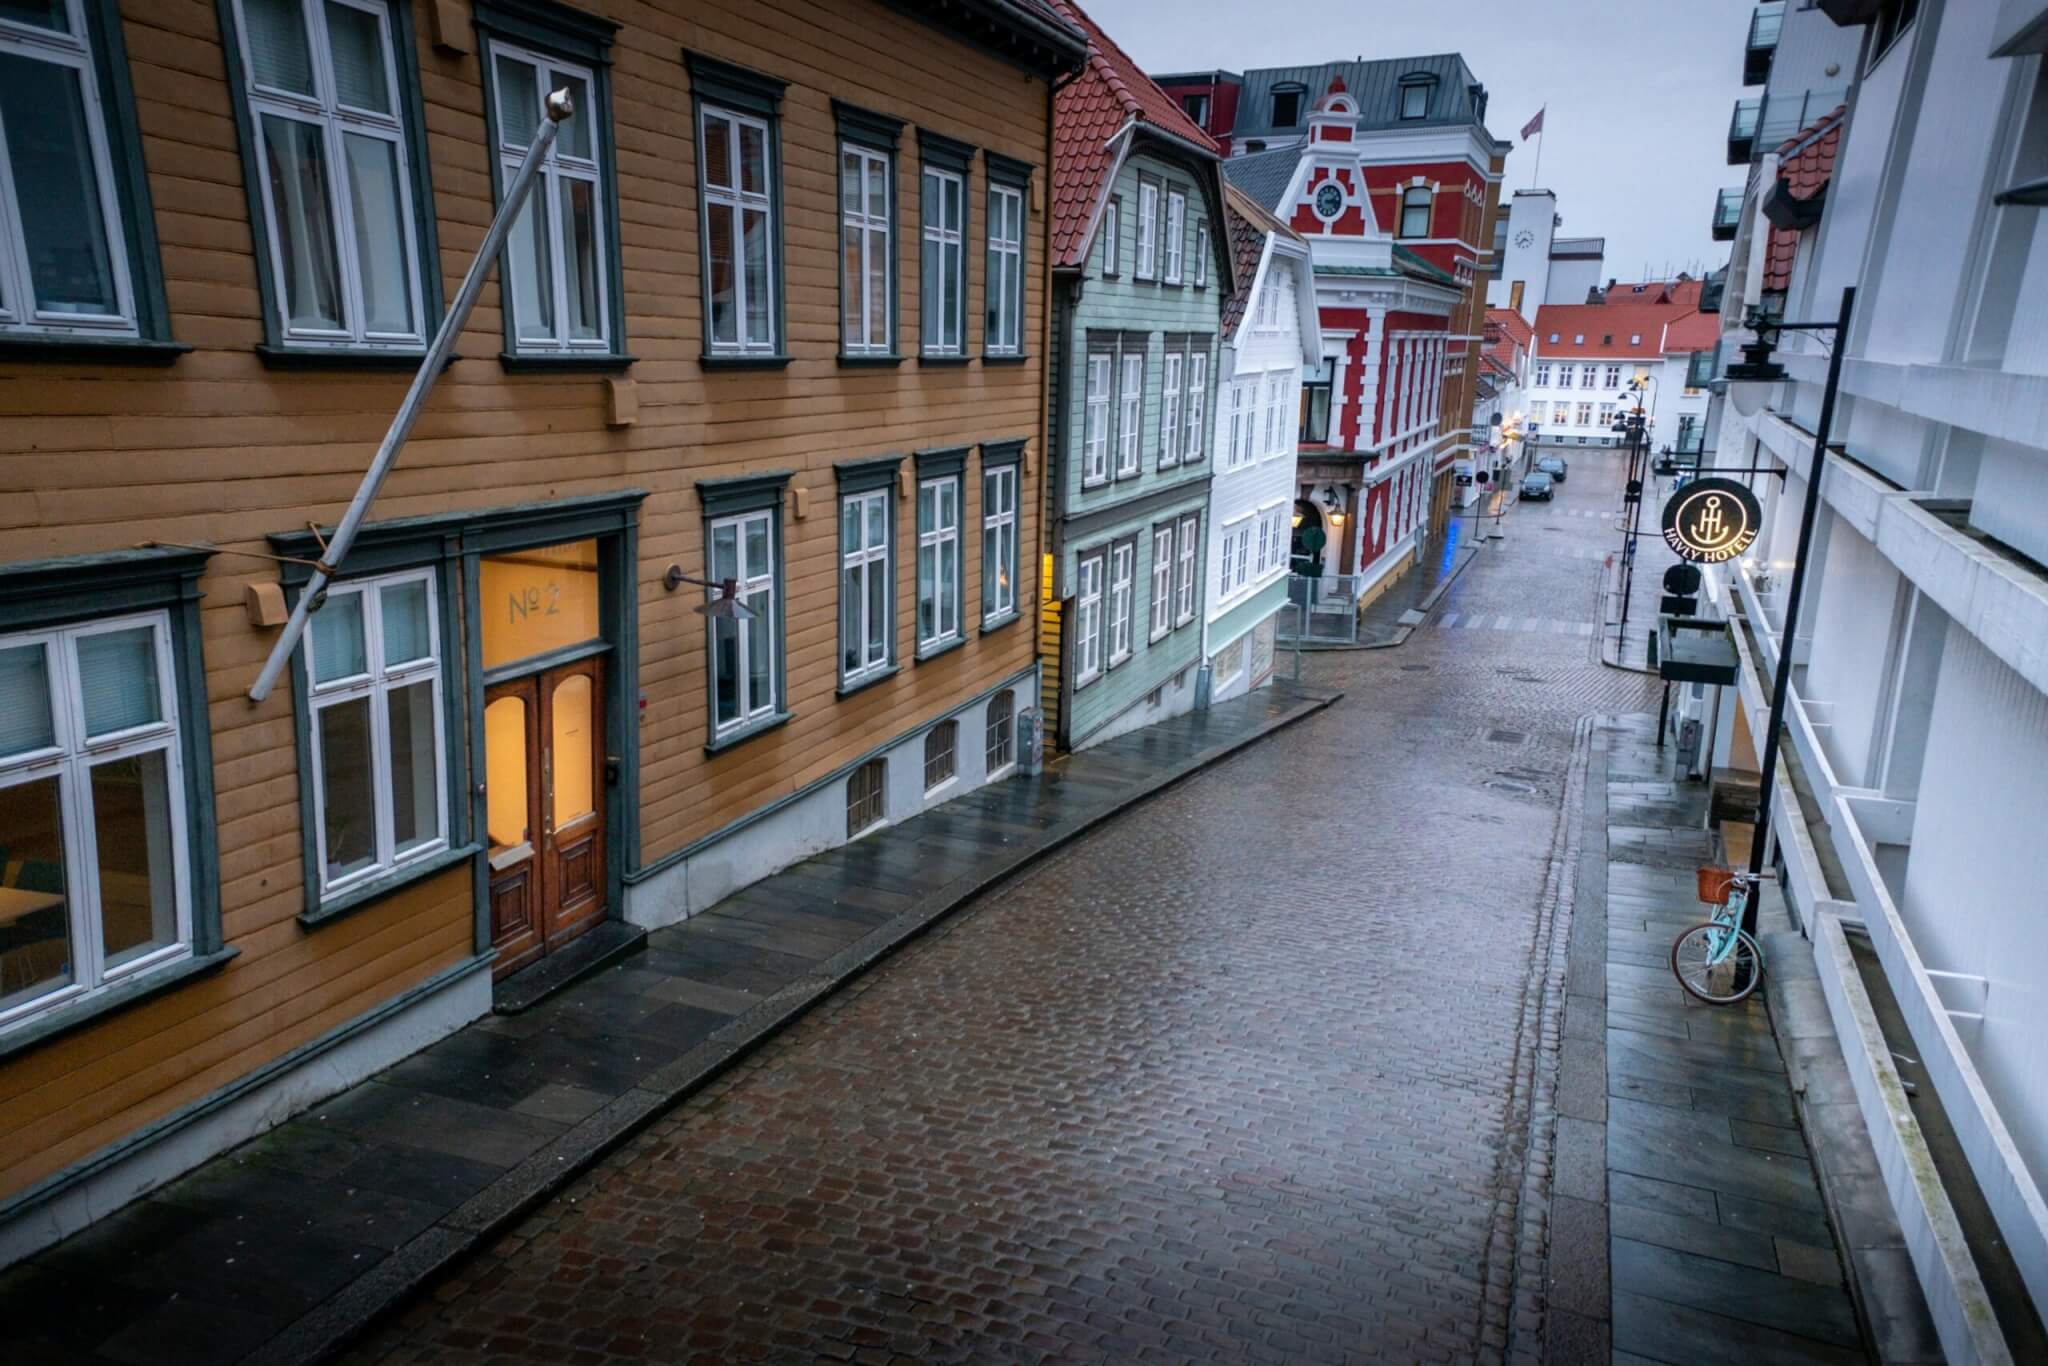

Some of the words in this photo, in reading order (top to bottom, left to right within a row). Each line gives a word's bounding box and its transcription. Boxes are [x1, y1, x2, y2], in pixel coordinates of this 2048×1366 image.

[1664, 527, 1701, 561] HAVLY
[1704, 528, 1757, 562] HOTELL
[545, 583, 560, 615] 2
